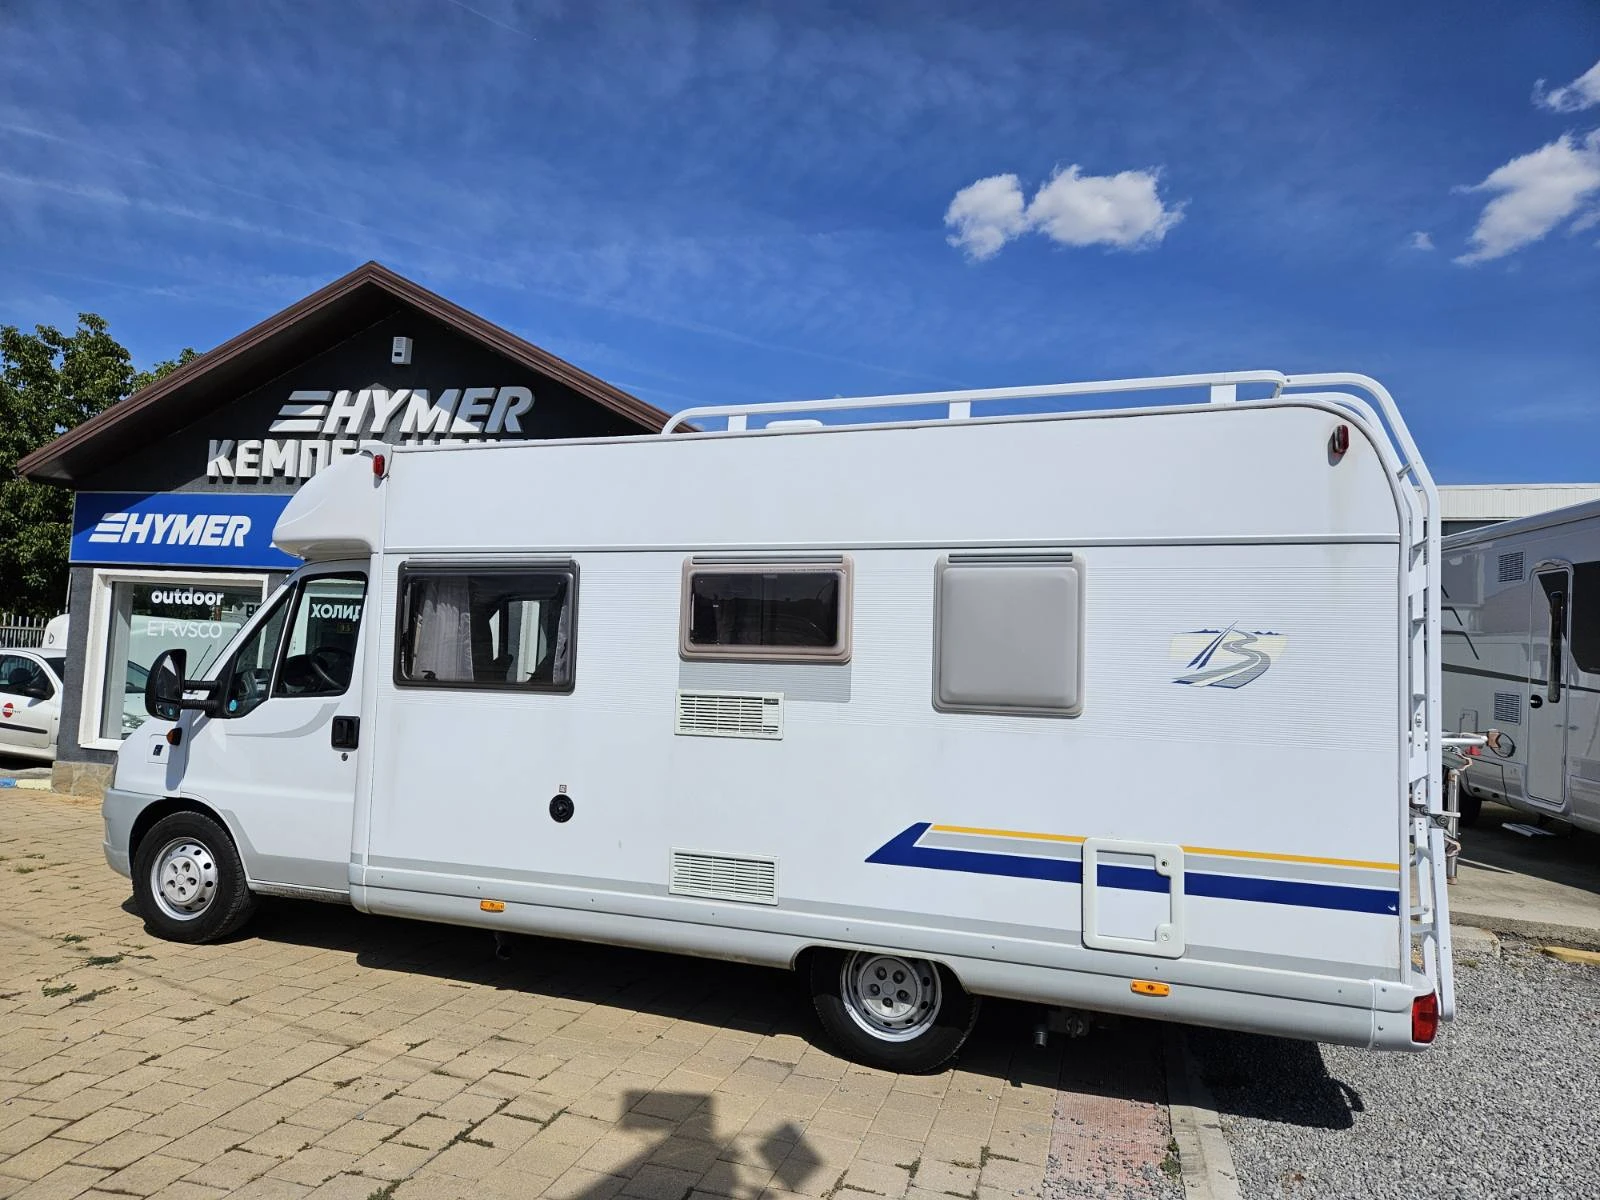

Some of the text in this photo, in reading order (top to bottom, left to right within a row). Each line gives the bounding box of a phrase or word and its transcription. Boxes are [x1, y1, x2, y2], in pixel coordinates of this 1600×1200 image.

[320, 386, 534, 433] HYMER
[119, 513, 251, 547] HYMER
[151, 587, 224, 606] outdoor
